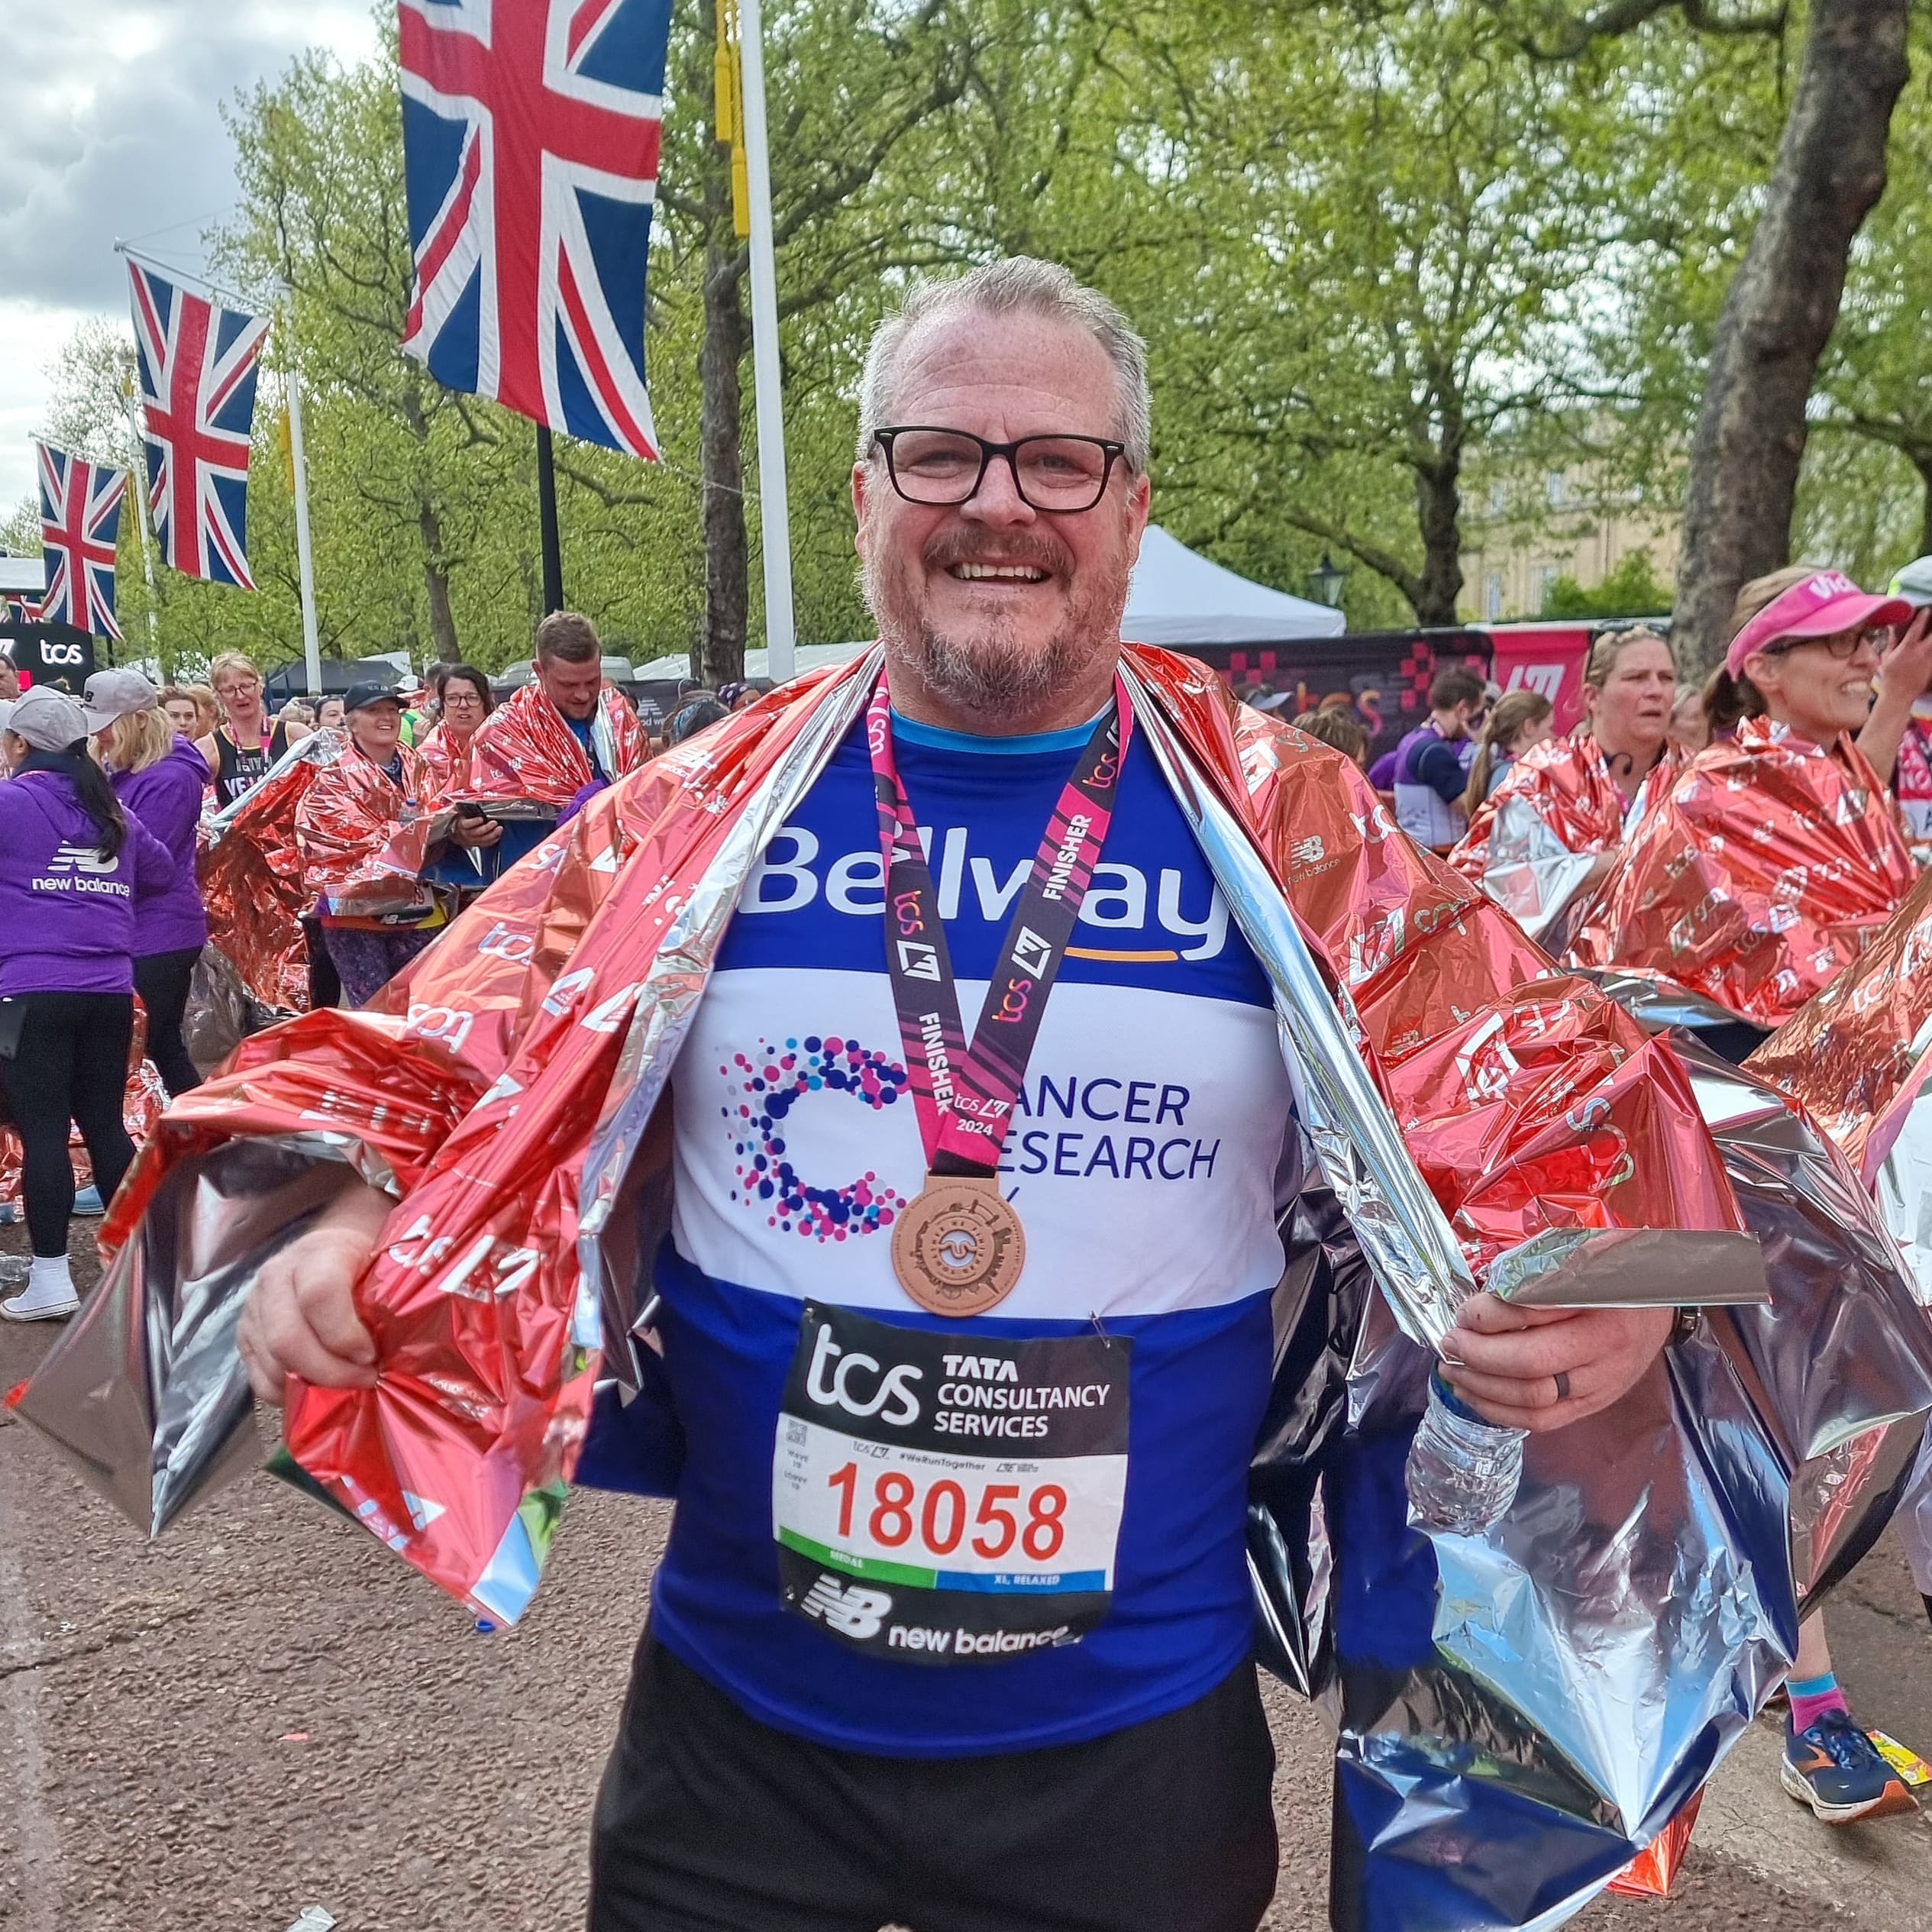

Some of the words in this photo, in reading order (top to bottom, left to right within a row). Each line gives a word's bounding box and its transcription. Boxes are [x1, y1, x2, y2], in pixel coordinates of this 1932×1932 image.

[39, 638, 83, 664] tcs
[1081, 753, 1118, 789] tcs
[1042, 813, 1093, 901] FINISHER
[32, 877, 72, 890] new
[74, 876, 130, 897] balance
[738, 826, 1230, 961] Belway
[893, 890, 924, 935] tcs
[478, 922, 535, 965] tc
[991, 977, 1032, 1023] tcs
[919, 1012, 954, 1116] FINISHER
[954, 1093, 981, 1111] tcs
[1016, 1075, 1190, 1126] ANCER
[956, 1119, 993, 1136] 2024
[997, 1130, 1220, 1180] ESEARCH
[806, 1323, 923, 1426] tcs
[942, 1354, 1019, 1383] TATA
[937, 1382, 1111, 1410] CONSULTANCY
[933, 1410, 1048, 1438] SERVICES
[900, 1452, 986, 1471] #WeRunTogether
[828, 1460, 1068, 1562] 18058
[1013, 1574, 1061, 1586] RELAXED
[888, 1625, 950, 1653] new
